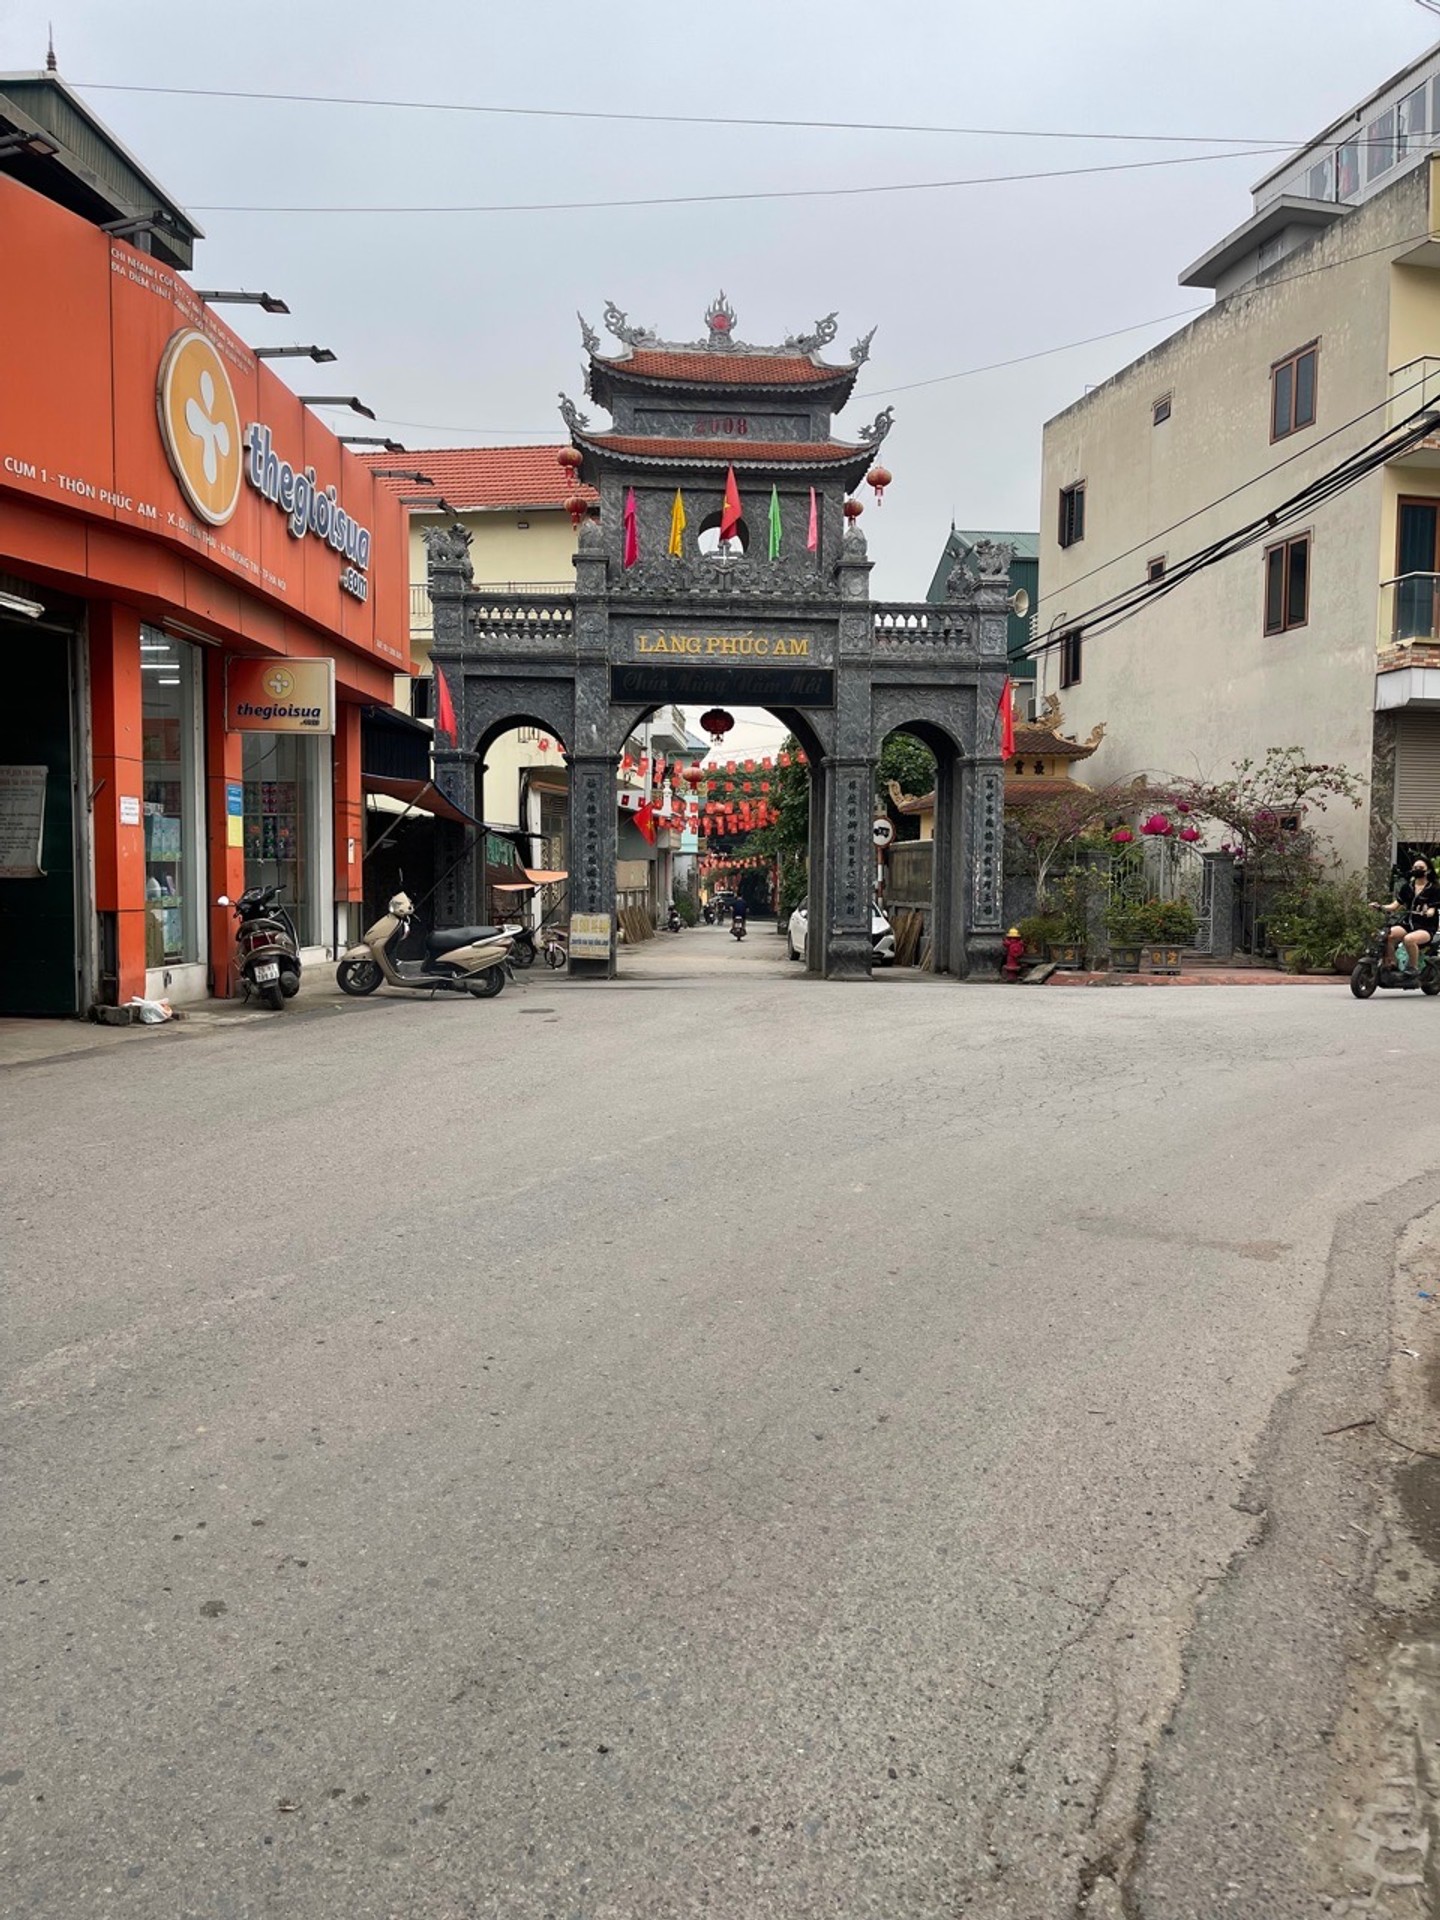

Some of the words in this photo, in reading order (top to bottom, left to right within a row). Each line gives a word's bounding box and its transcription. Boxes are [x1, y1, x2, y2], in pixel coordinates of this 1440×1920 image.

[692, 415, 748, 436] 2008
[4, 456, 36, 479] CỤM
[40, 467, 47, 483] 1
[57, 473, 96, 499] THÔN
[100, 489, 133, 511] PHÚC
[137, 502, 156, 519] AM
[246, 422, 371, 570] thegioisua
[638, 628, 701, 653] LÀNG
[706, 630, 768, 656] PHÚC
[772, 638, 809, 656] AM
[237, 702, 321, 720] thegioisua
